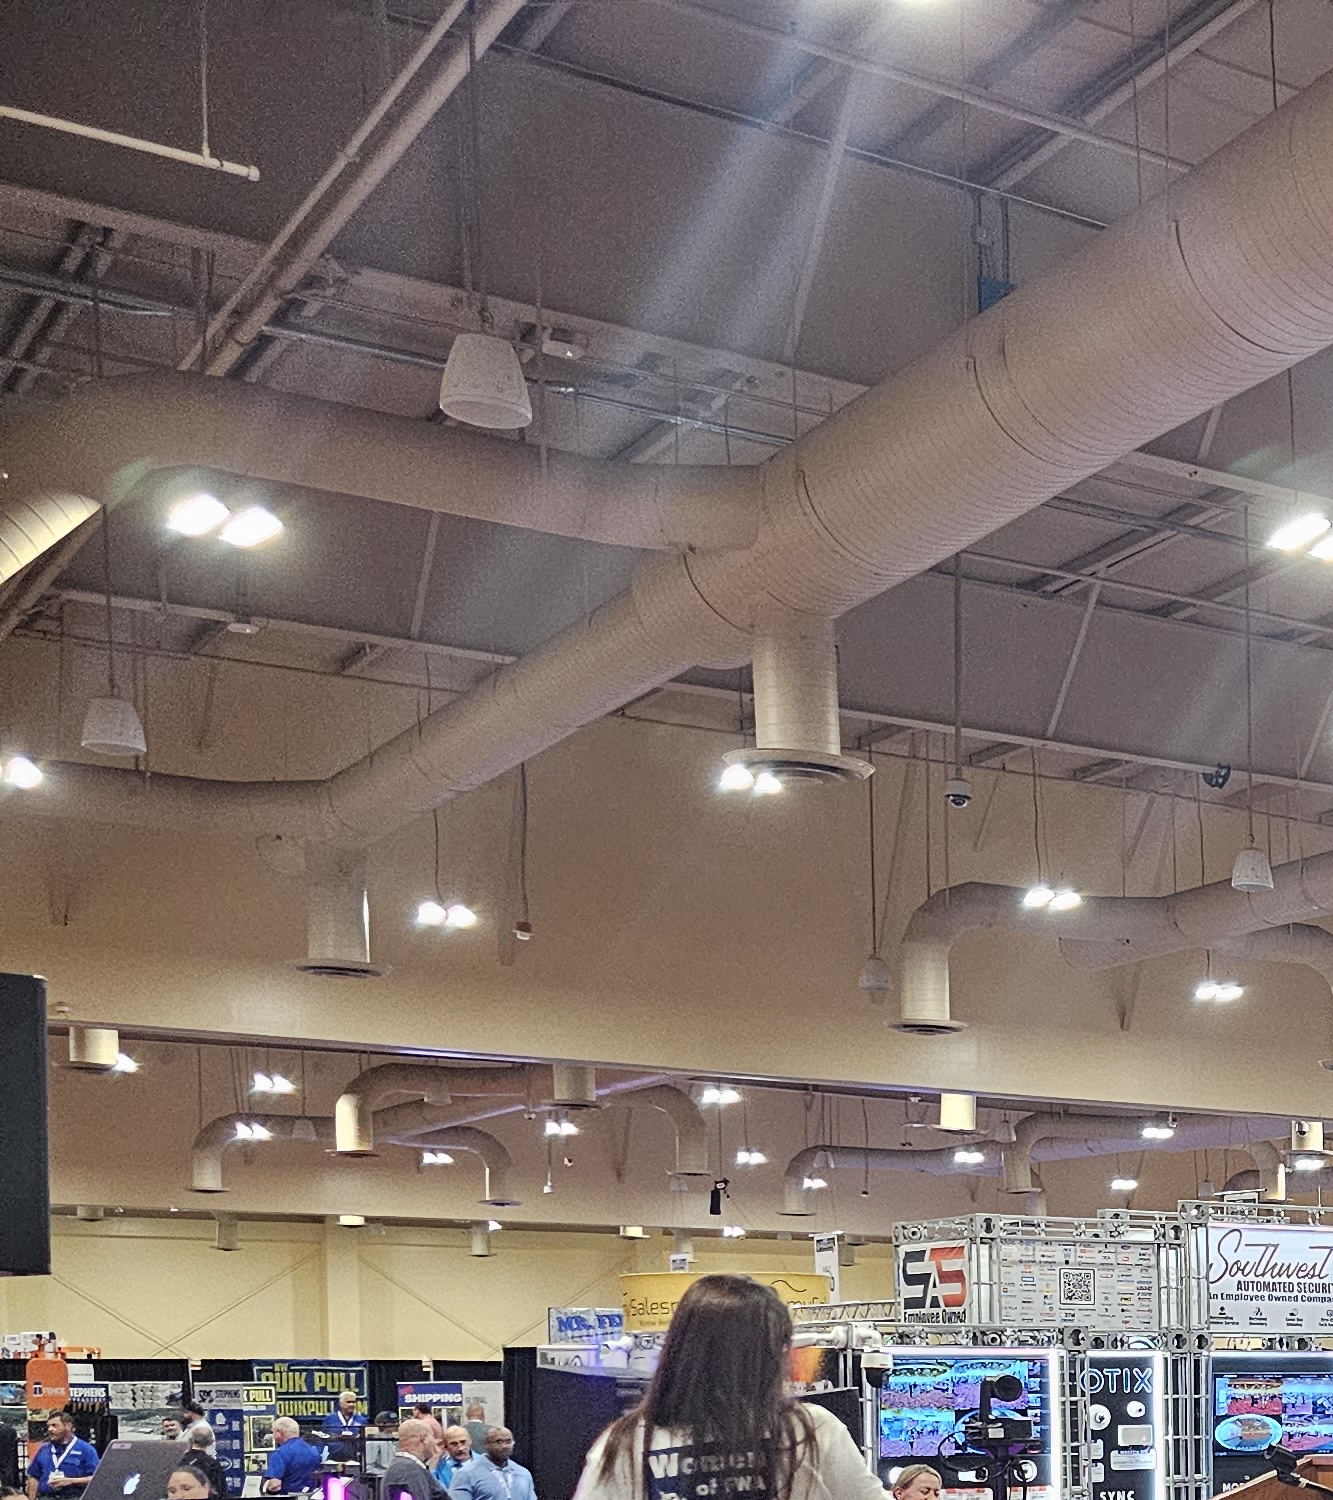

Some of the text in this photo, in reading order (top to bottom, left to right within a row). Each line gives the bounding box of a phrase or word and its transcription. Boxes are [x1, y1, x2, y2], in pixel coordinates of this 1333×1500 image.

[1237, 1280, 1294, 1293] AUTOMATED
[1221, 1293, 1265, 1301] Employee
[1268, 1294, 1298, 1302] Owned
[314, 1372, 358, 1392] PULL
[405, 1394, 462, 1402] SHIPPING
